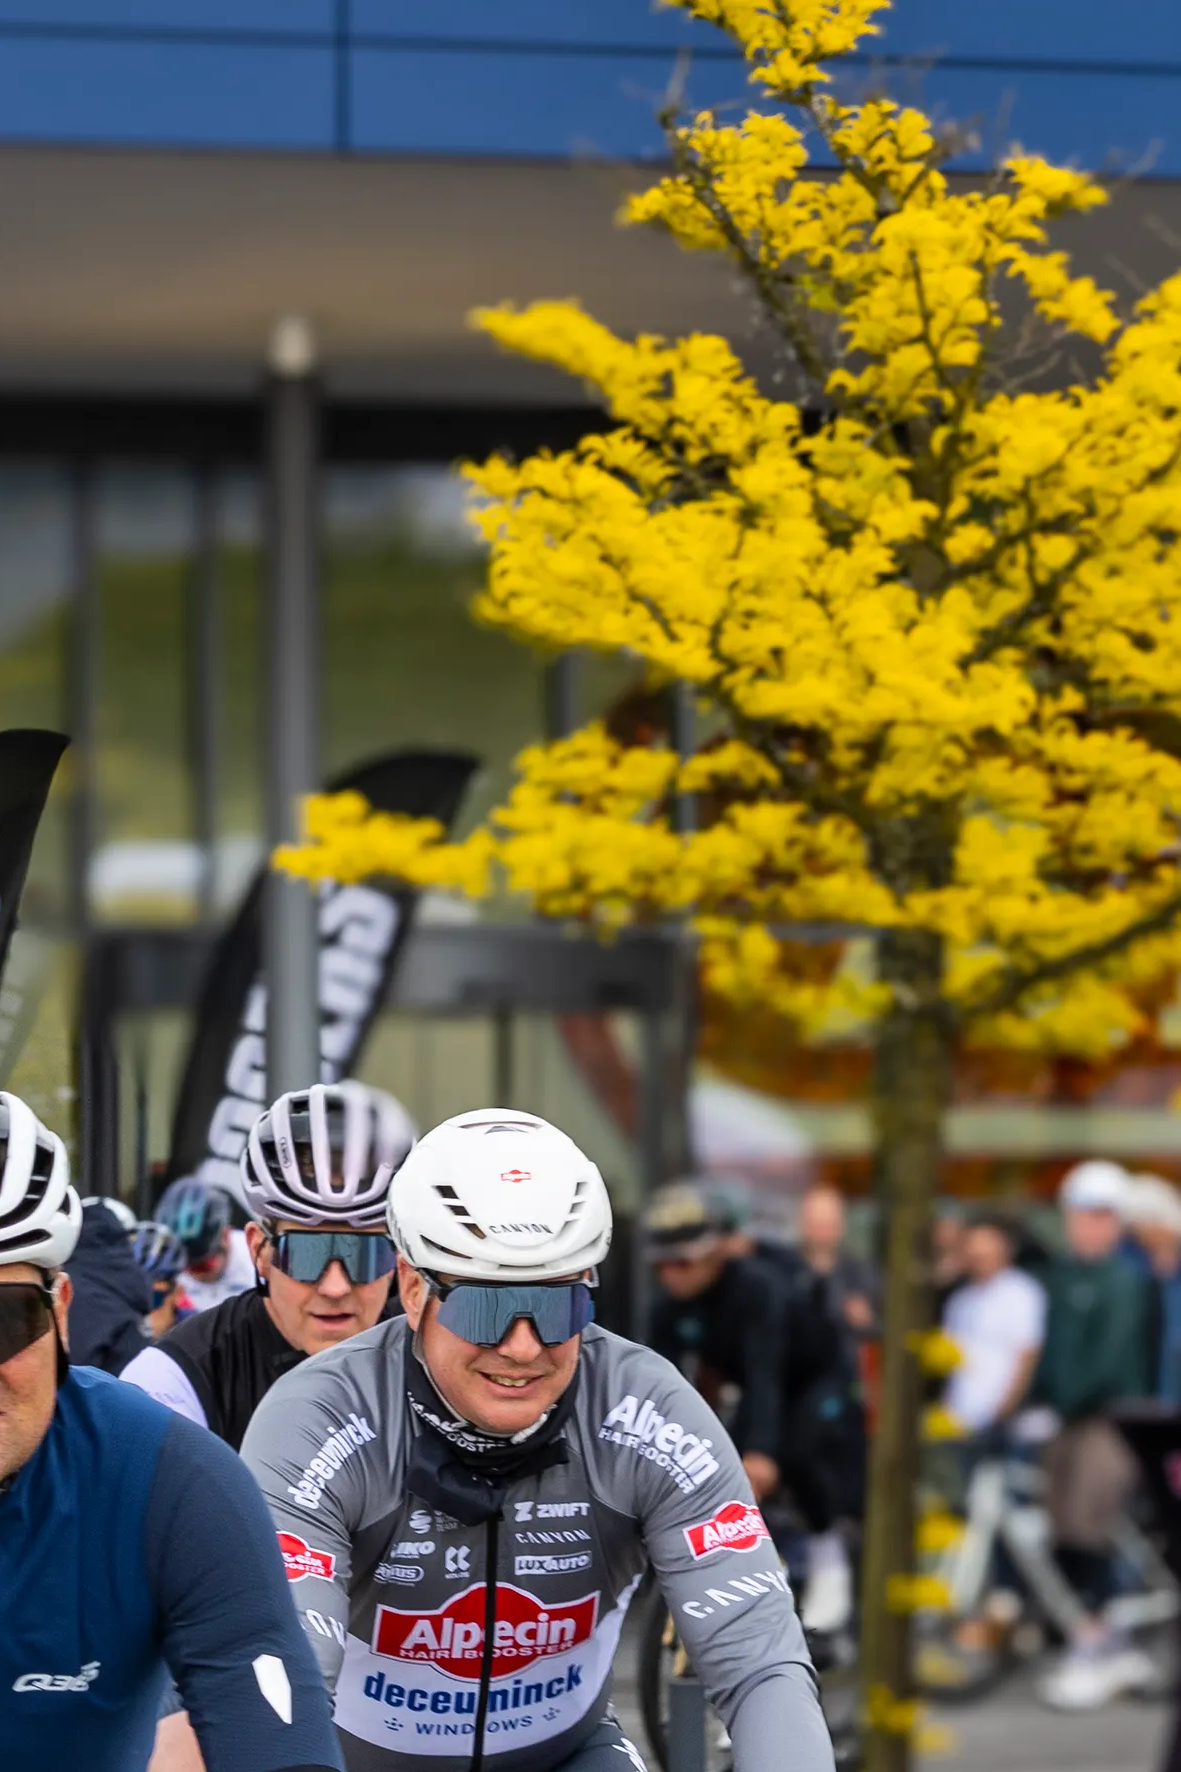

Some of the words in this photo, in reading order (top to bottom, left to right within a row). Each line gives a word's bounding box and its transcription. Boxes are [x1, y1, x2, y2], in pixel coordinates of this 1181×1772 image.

[489, 1223, 553, 1234] CANYON
[602, 1395, 719, 1485] Alpecin
[536, 1502, 591, 1518] ZWIFT
[515, 1529, 591, 1544] CANYON
[682, 1570, 793, 1619] CANYO
[400, 1612, 577, 1658] Alpecin
[399, 1649, 447, 1660] HAIR
[364, 1663, 584, 1715] deceuninck
[415, 1716, 533, 1736] WINDOWS
